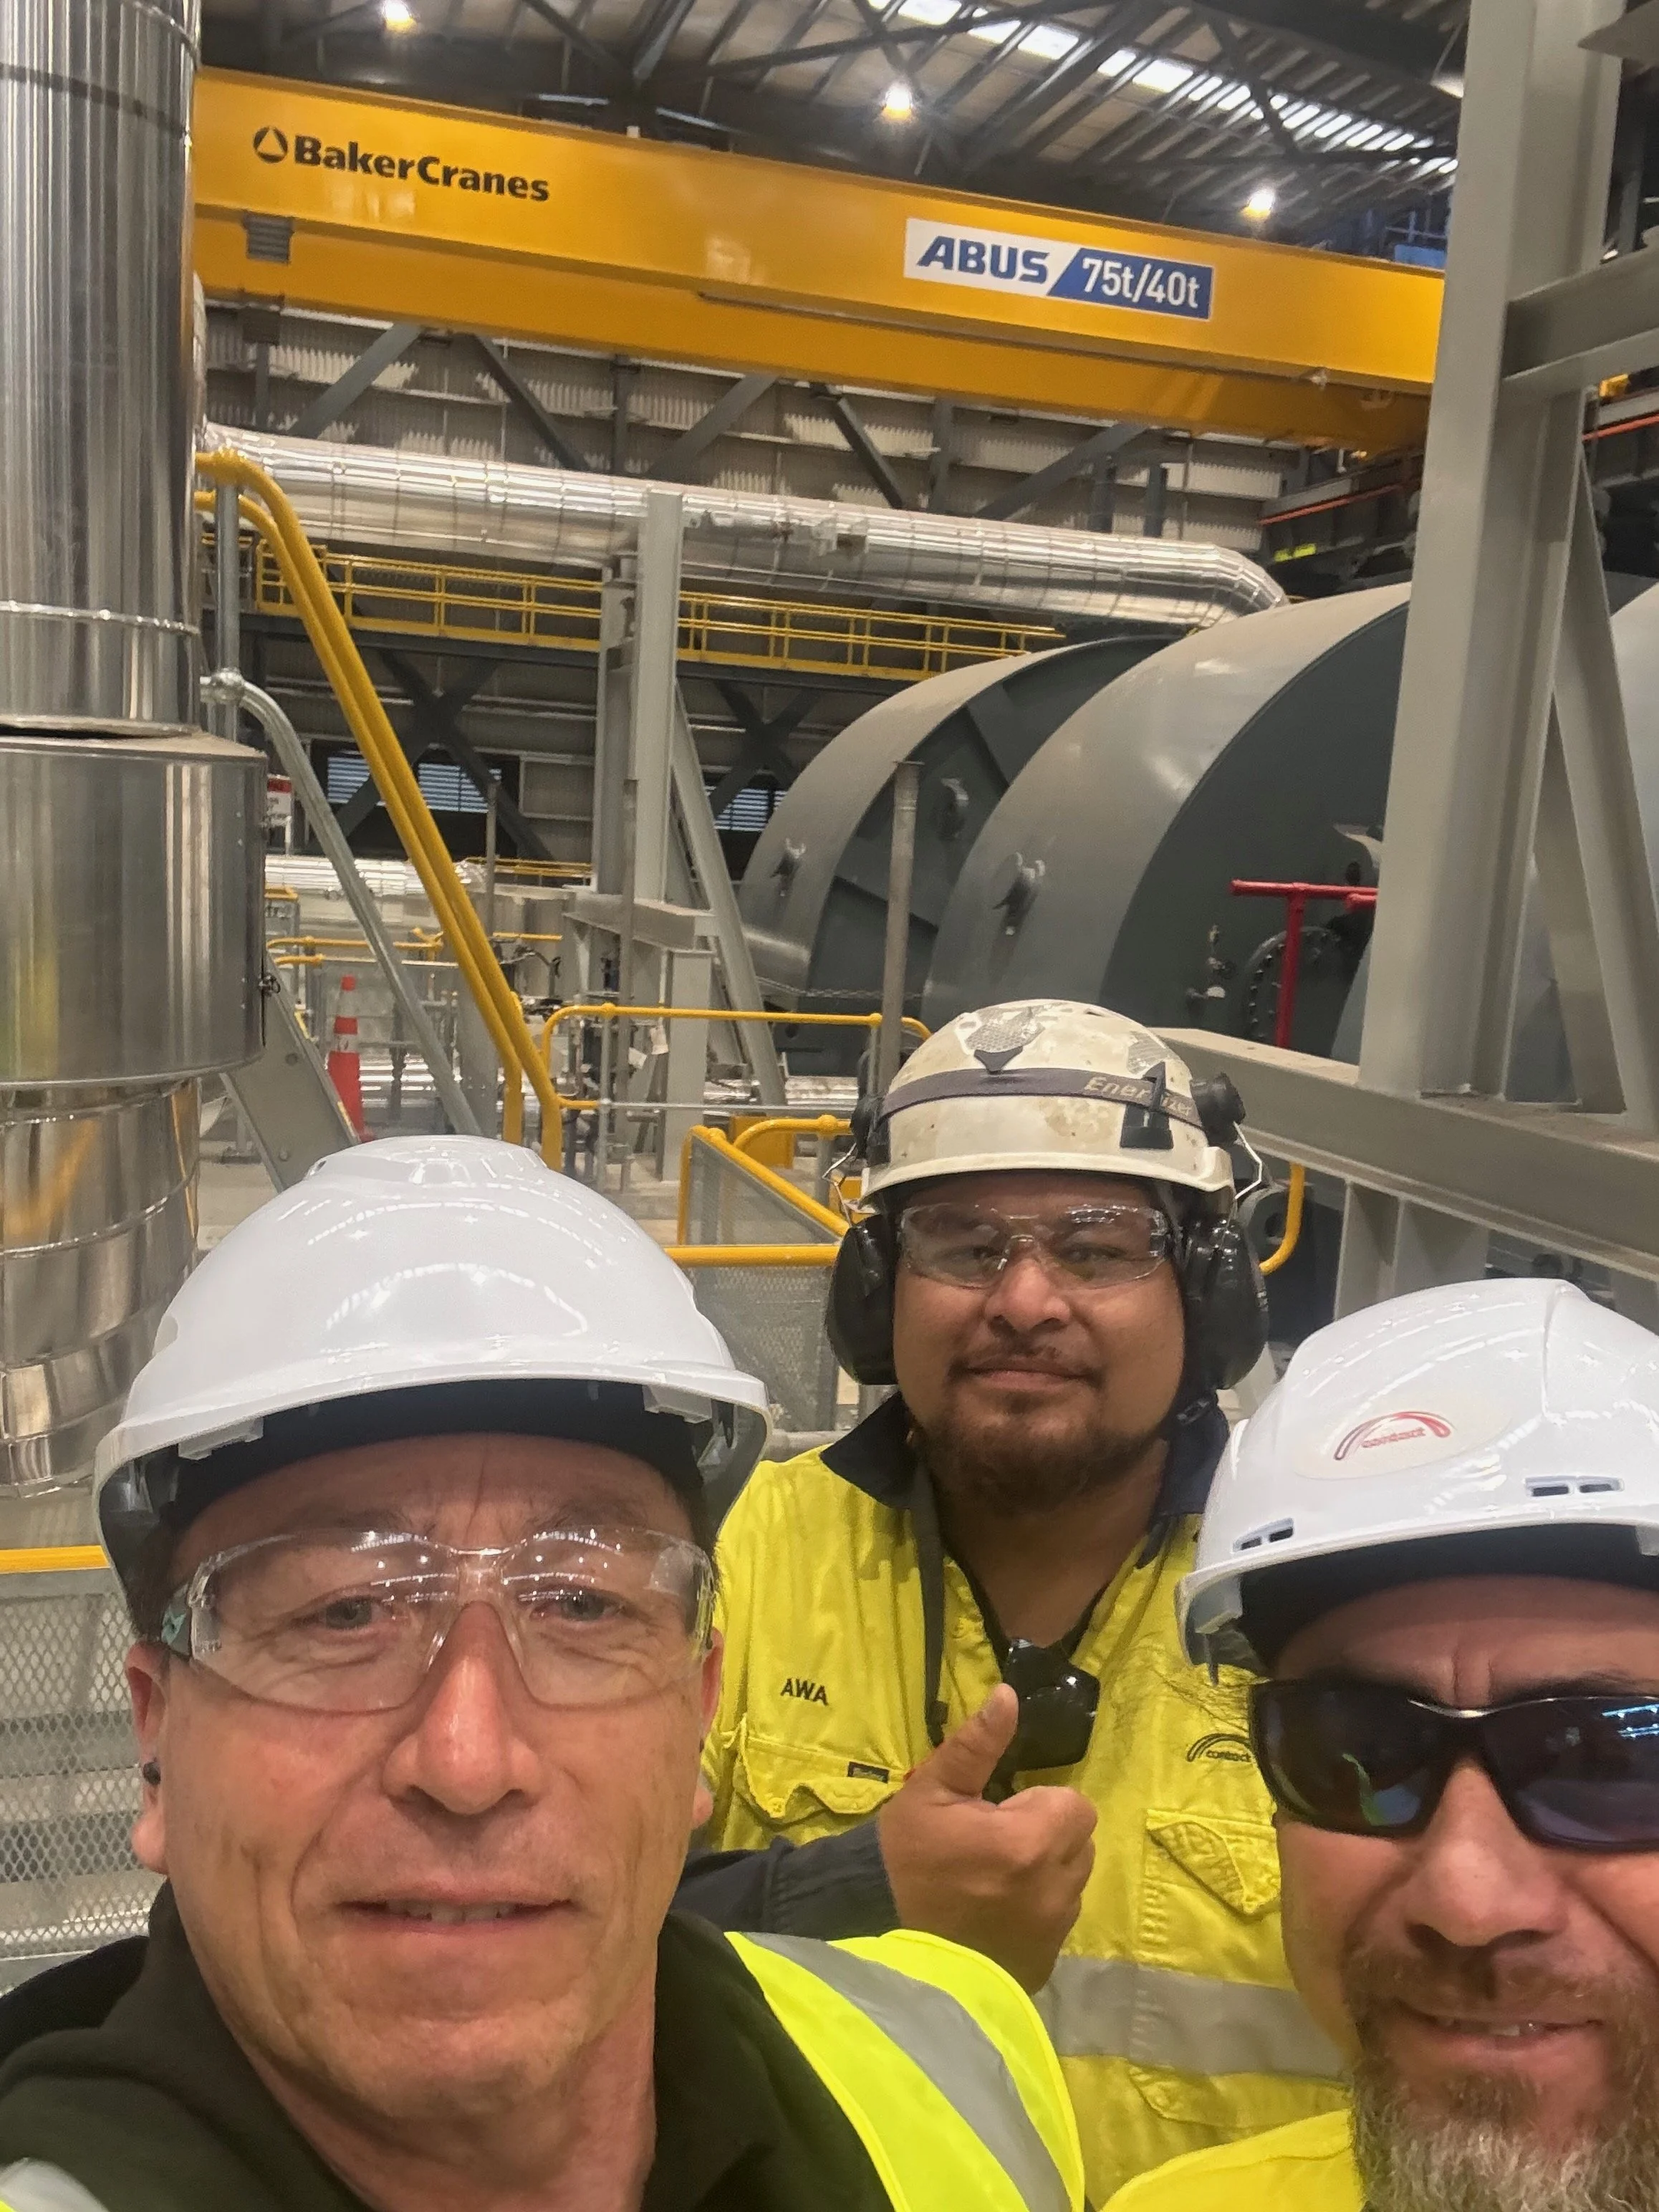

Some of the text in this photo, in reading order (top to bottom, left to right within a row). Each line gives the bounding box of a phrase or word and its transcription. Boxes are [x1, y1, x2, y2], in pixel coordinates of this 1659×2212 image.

[294, 133, 550, 202] BakerCranes
[916, 235, 1201, 309] ABUS 75t/40t
[780, 1678, 830, 1706] AWA
